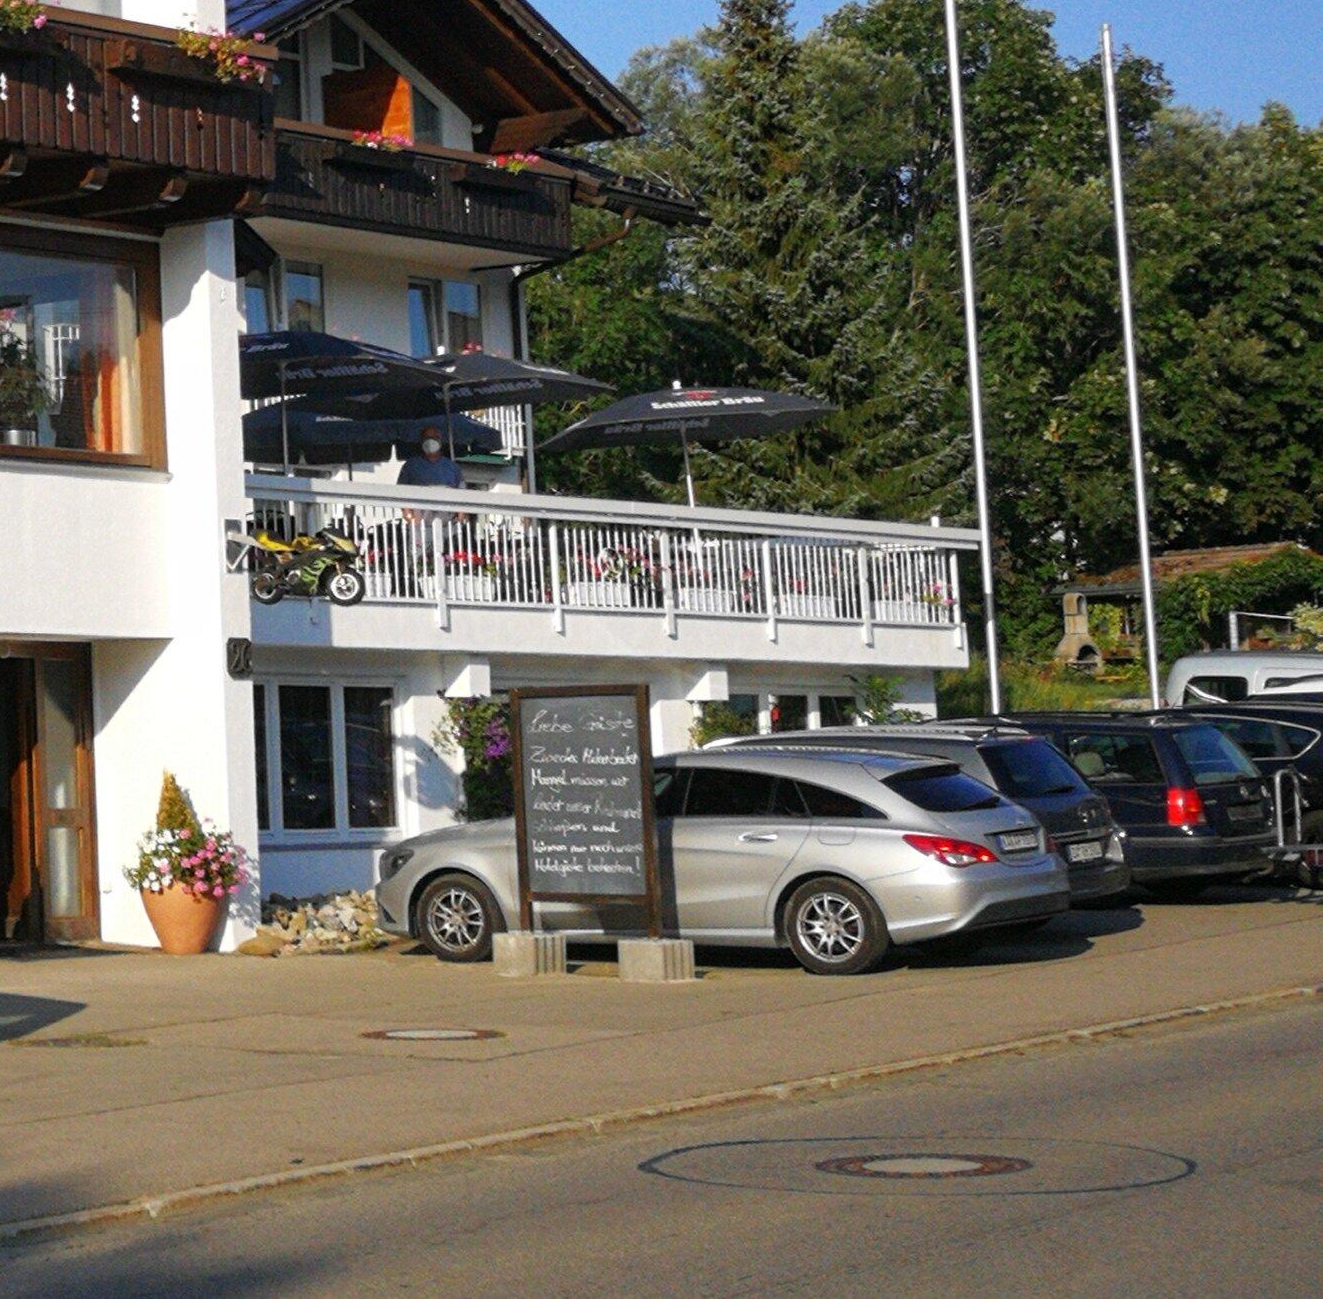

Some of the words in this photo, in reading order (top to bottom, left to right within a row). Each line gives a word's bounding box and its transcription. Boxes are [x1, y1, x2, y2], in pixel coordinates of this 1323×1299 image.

[651, 399, 720, 410] Schäffler
[720, 396, 765, 406] Bräu
[527, 709, 574, 733] Liebe
[530, 768, 569, 792] Mangel
[570, 772, 608, 787] müssen
[610, 776, 630, 787] wir
[591, 822, 620, 833] und
[533, 840, 567, 853] können
[570, 845, 588, 853] nur
[590, 840, 615, 853] noch
[535, 857, 584, 878] Hotelgäste
